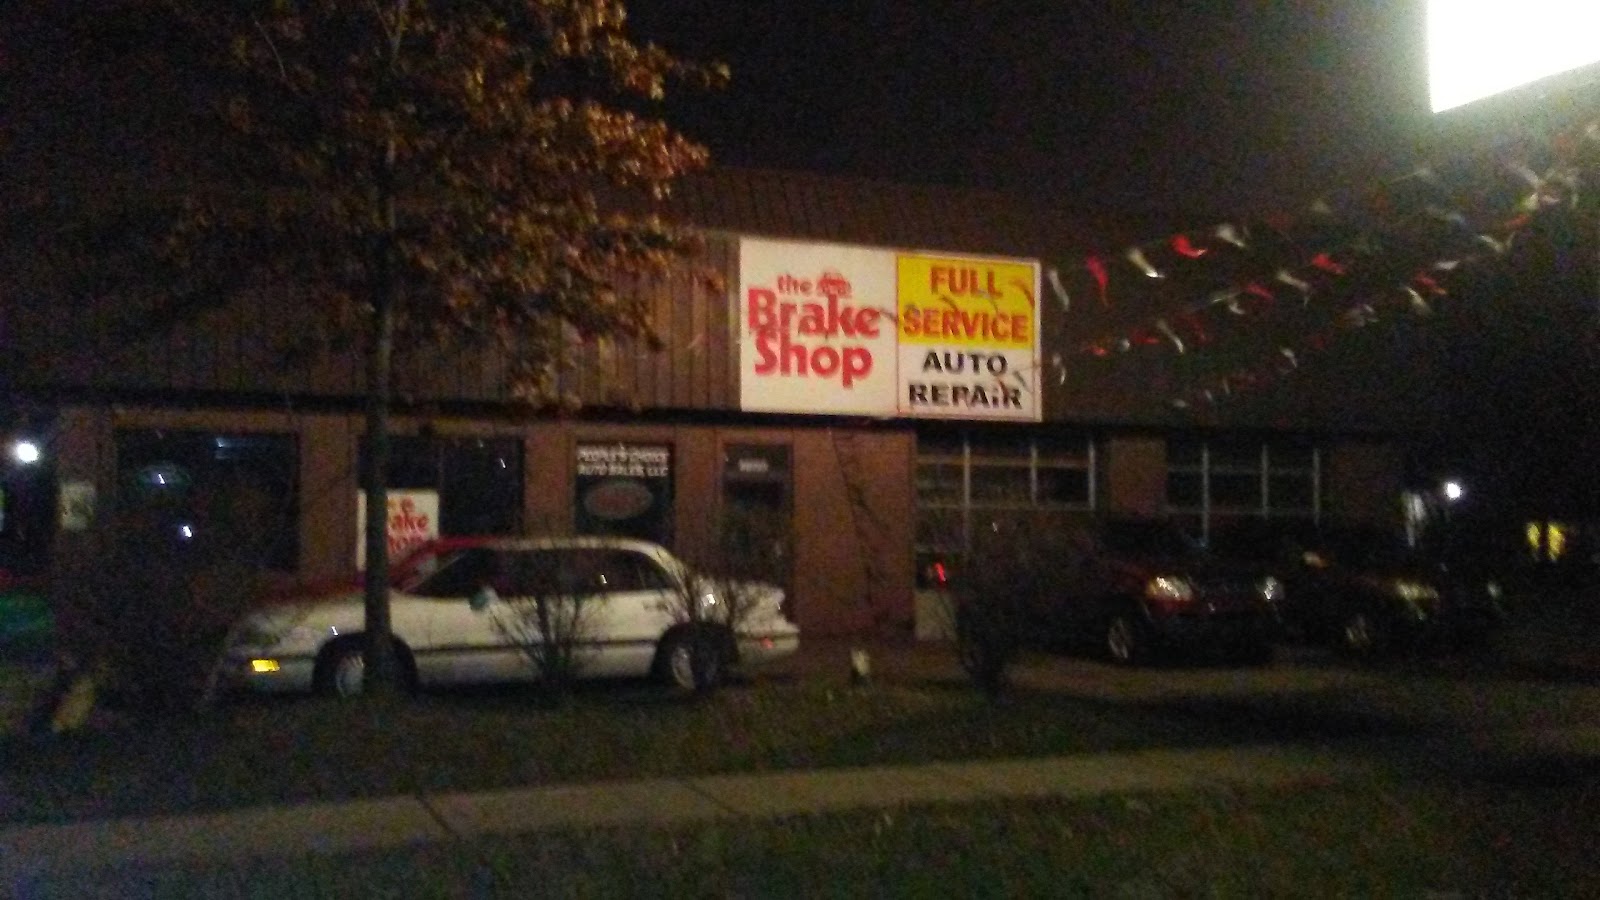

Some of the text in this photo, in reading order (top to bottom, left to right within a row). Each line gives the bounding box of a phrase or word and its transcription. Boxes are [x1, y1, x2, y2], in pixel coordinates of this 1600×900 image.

[777, 273, 812, 295] the
[930, 266, 1003, 298] FULL
[748, 288, 881, 339] Brake
[903, 307, 1029, 342] SERVICE
[755, 326, 874, 389] Shop
[922, 352, 1008, 376] AUTO
[908, 384, 1024, 410] REPAIR
